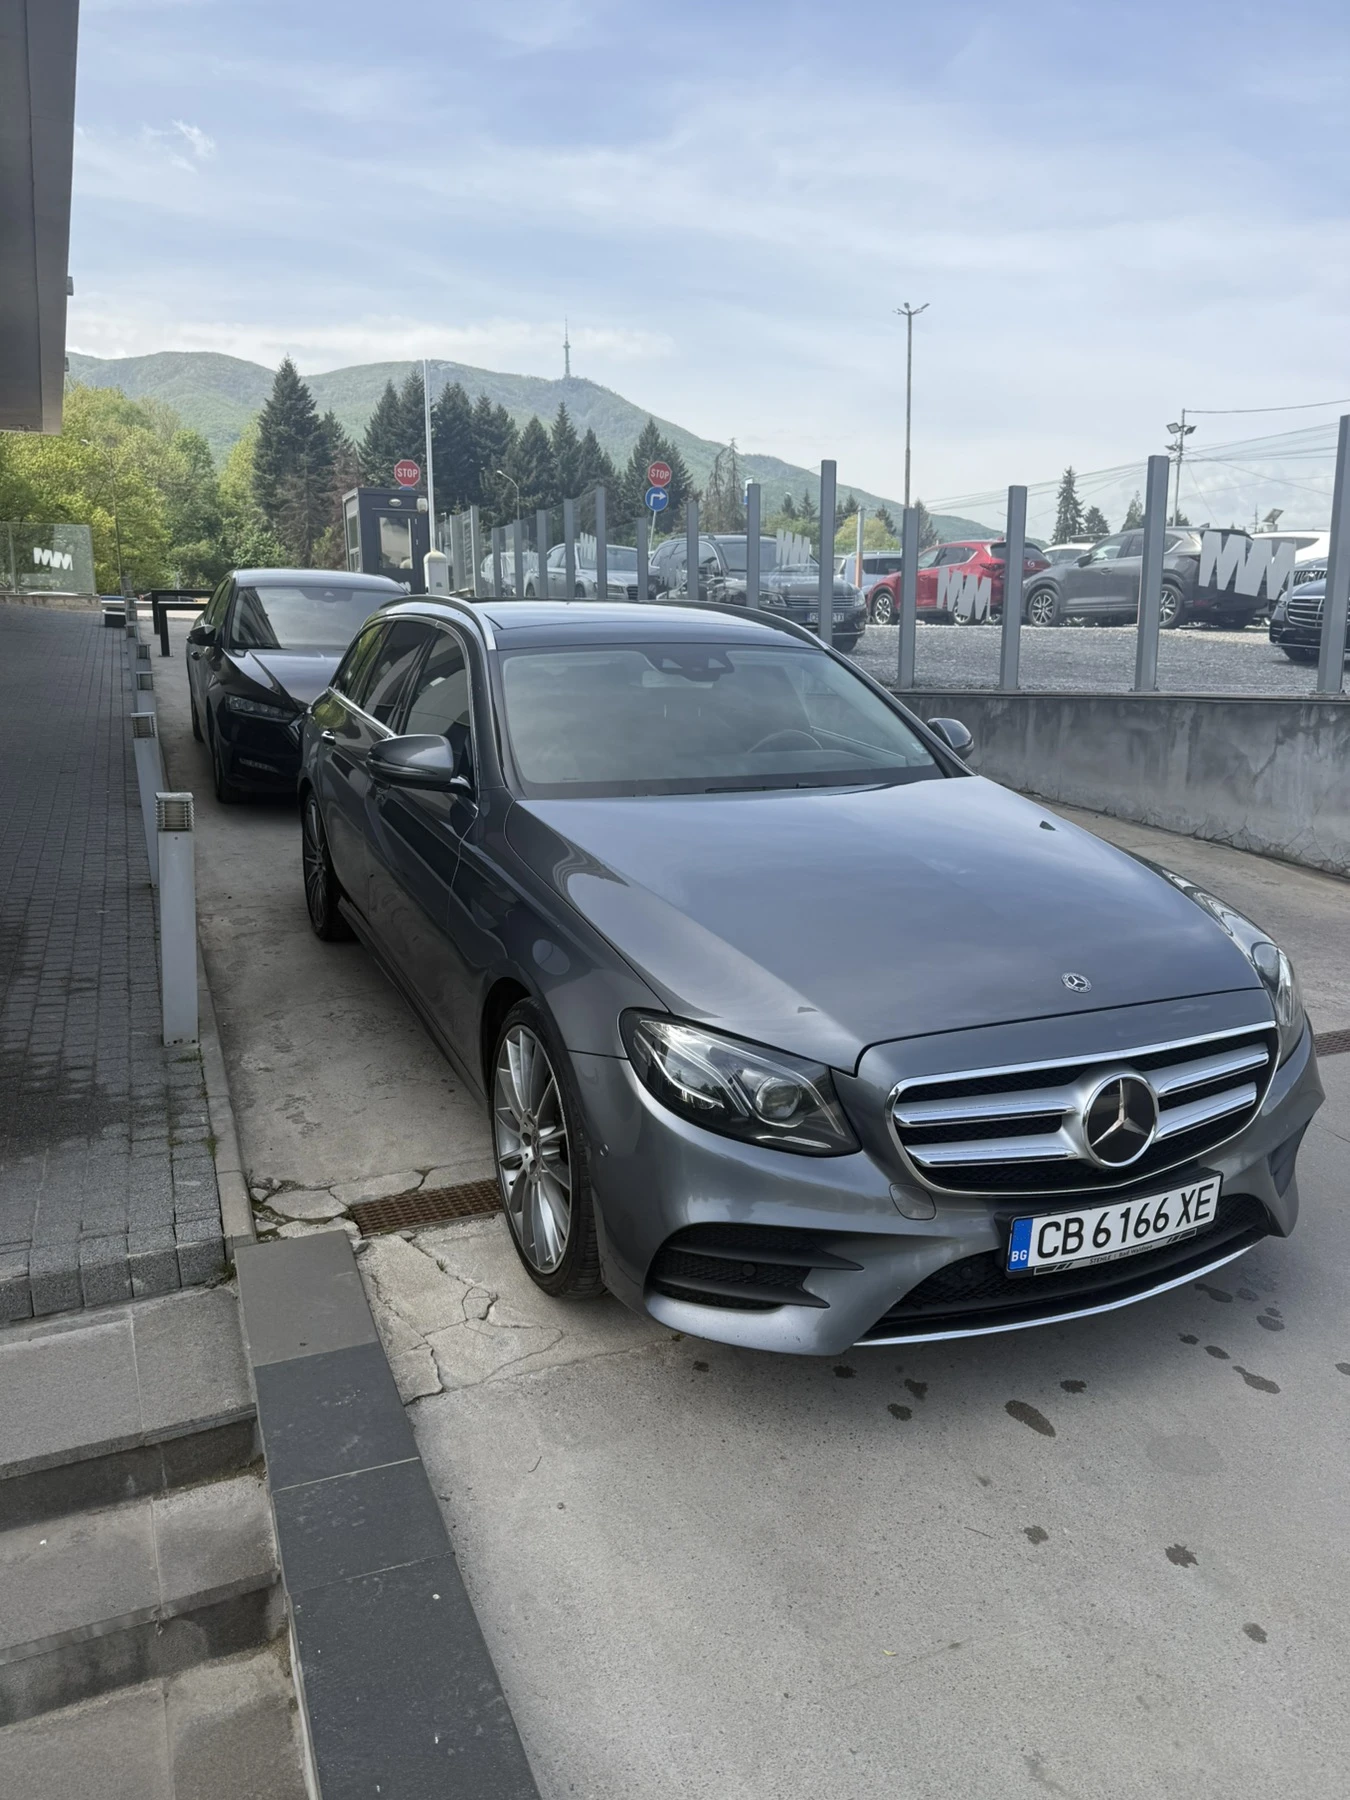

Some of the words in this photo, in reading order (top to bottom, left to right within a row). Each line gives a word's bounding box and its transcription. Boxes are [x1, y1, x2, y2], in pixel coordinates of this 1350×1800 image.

[397, 467, 418, 478] STOP
[650, 468, 670, 480] STOP
[1037, 1217, 1084, 1259] CB
[1092, 1197, 1170, 1249] 6166
[1175, 1183, 1215, 1228] XE
[1011, 1250, 1028, 1262] BG
